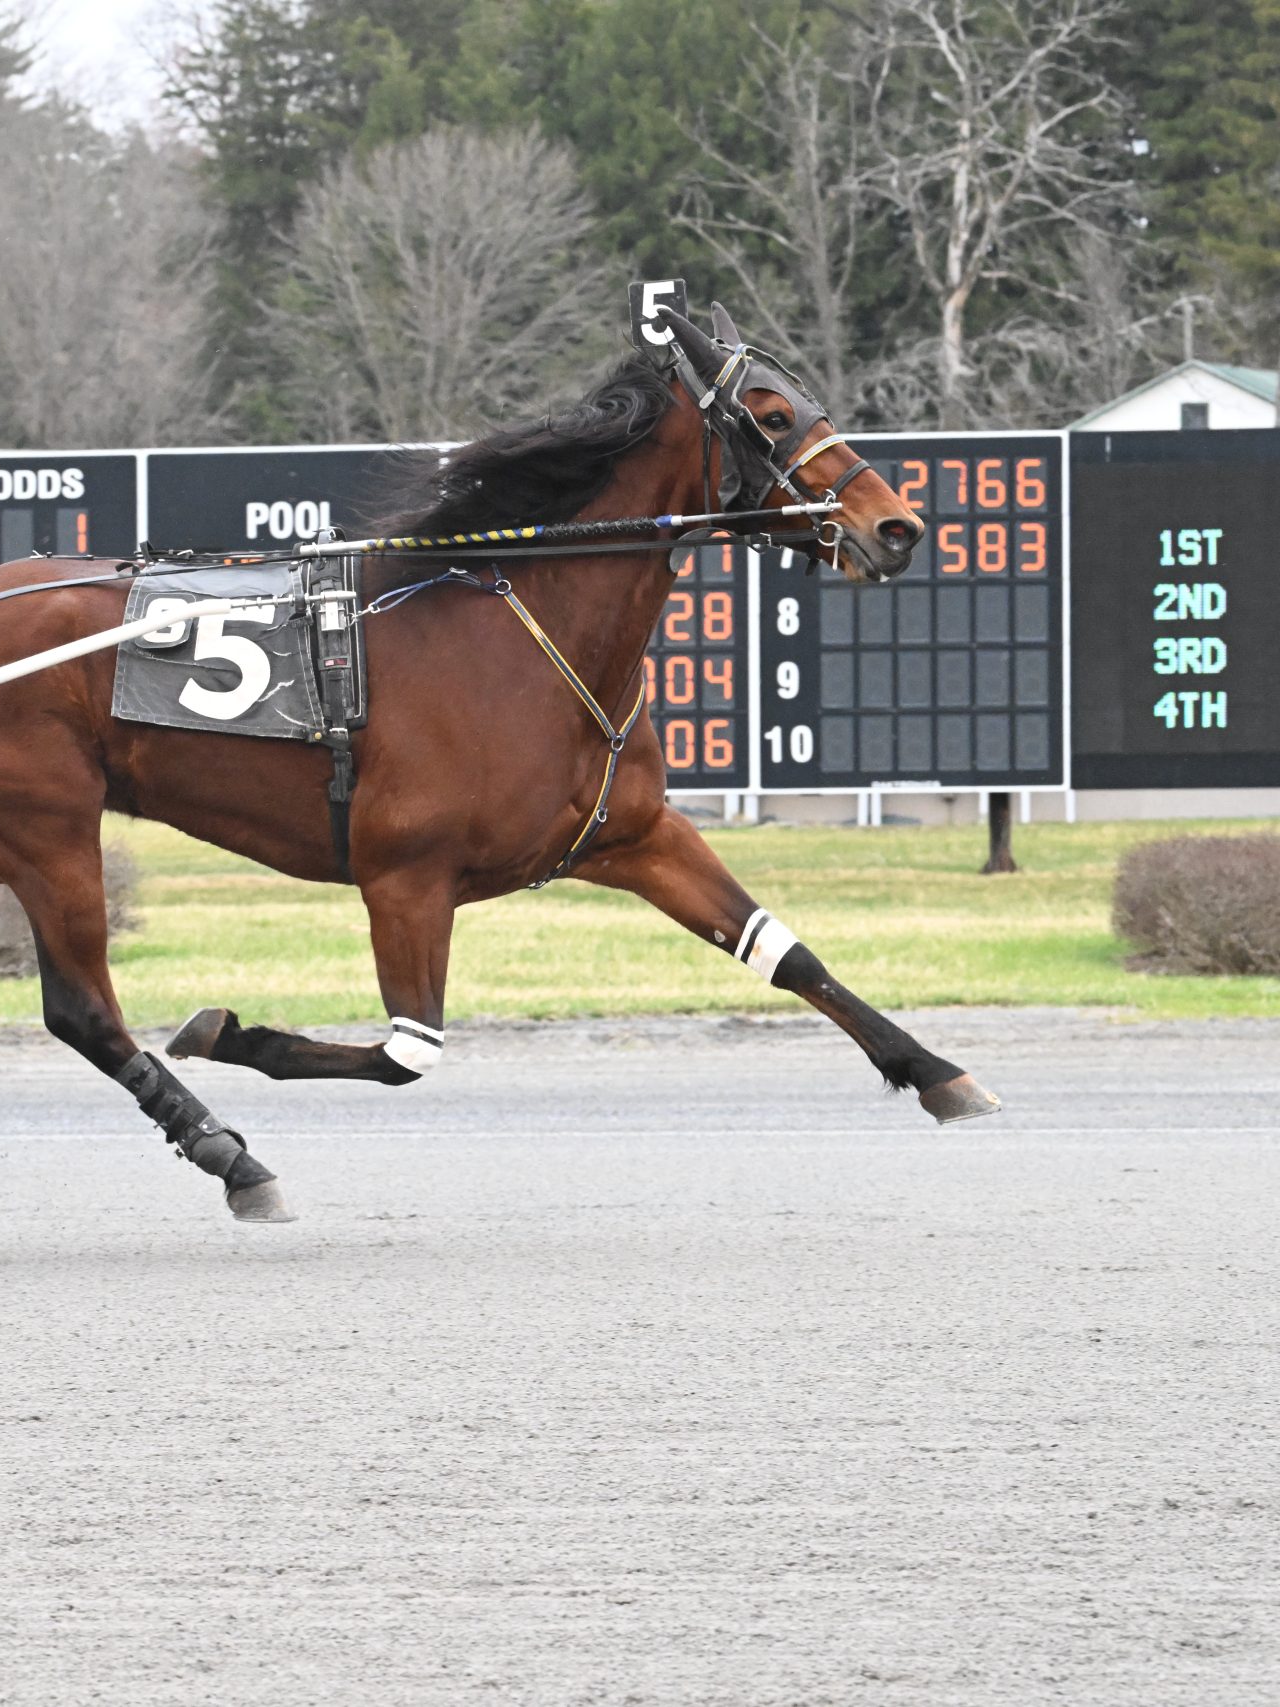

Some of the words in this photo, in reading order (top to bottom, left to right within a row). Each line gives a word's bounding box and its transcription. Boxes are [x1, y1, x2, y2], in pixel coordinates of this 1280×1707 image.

[641, 281, 675, 345] 5
[899, 458, 1046, 508] 2766
[76, 513, 87, 553] 1
[938, 523, 1047, 573] 583
[1160, 528, 1223, 566] 1ST
[777, 597, 800, 636] 8
[1153, 583, 1227, 620] 2ND
[179, 599, 276, 720] 5
[1153, 637, 1227, 675] 3RD
[777, 661, 800, 700] 9
[1153, 691, 1227, 729] 4TH
[764, 725, 813, 763] 10
